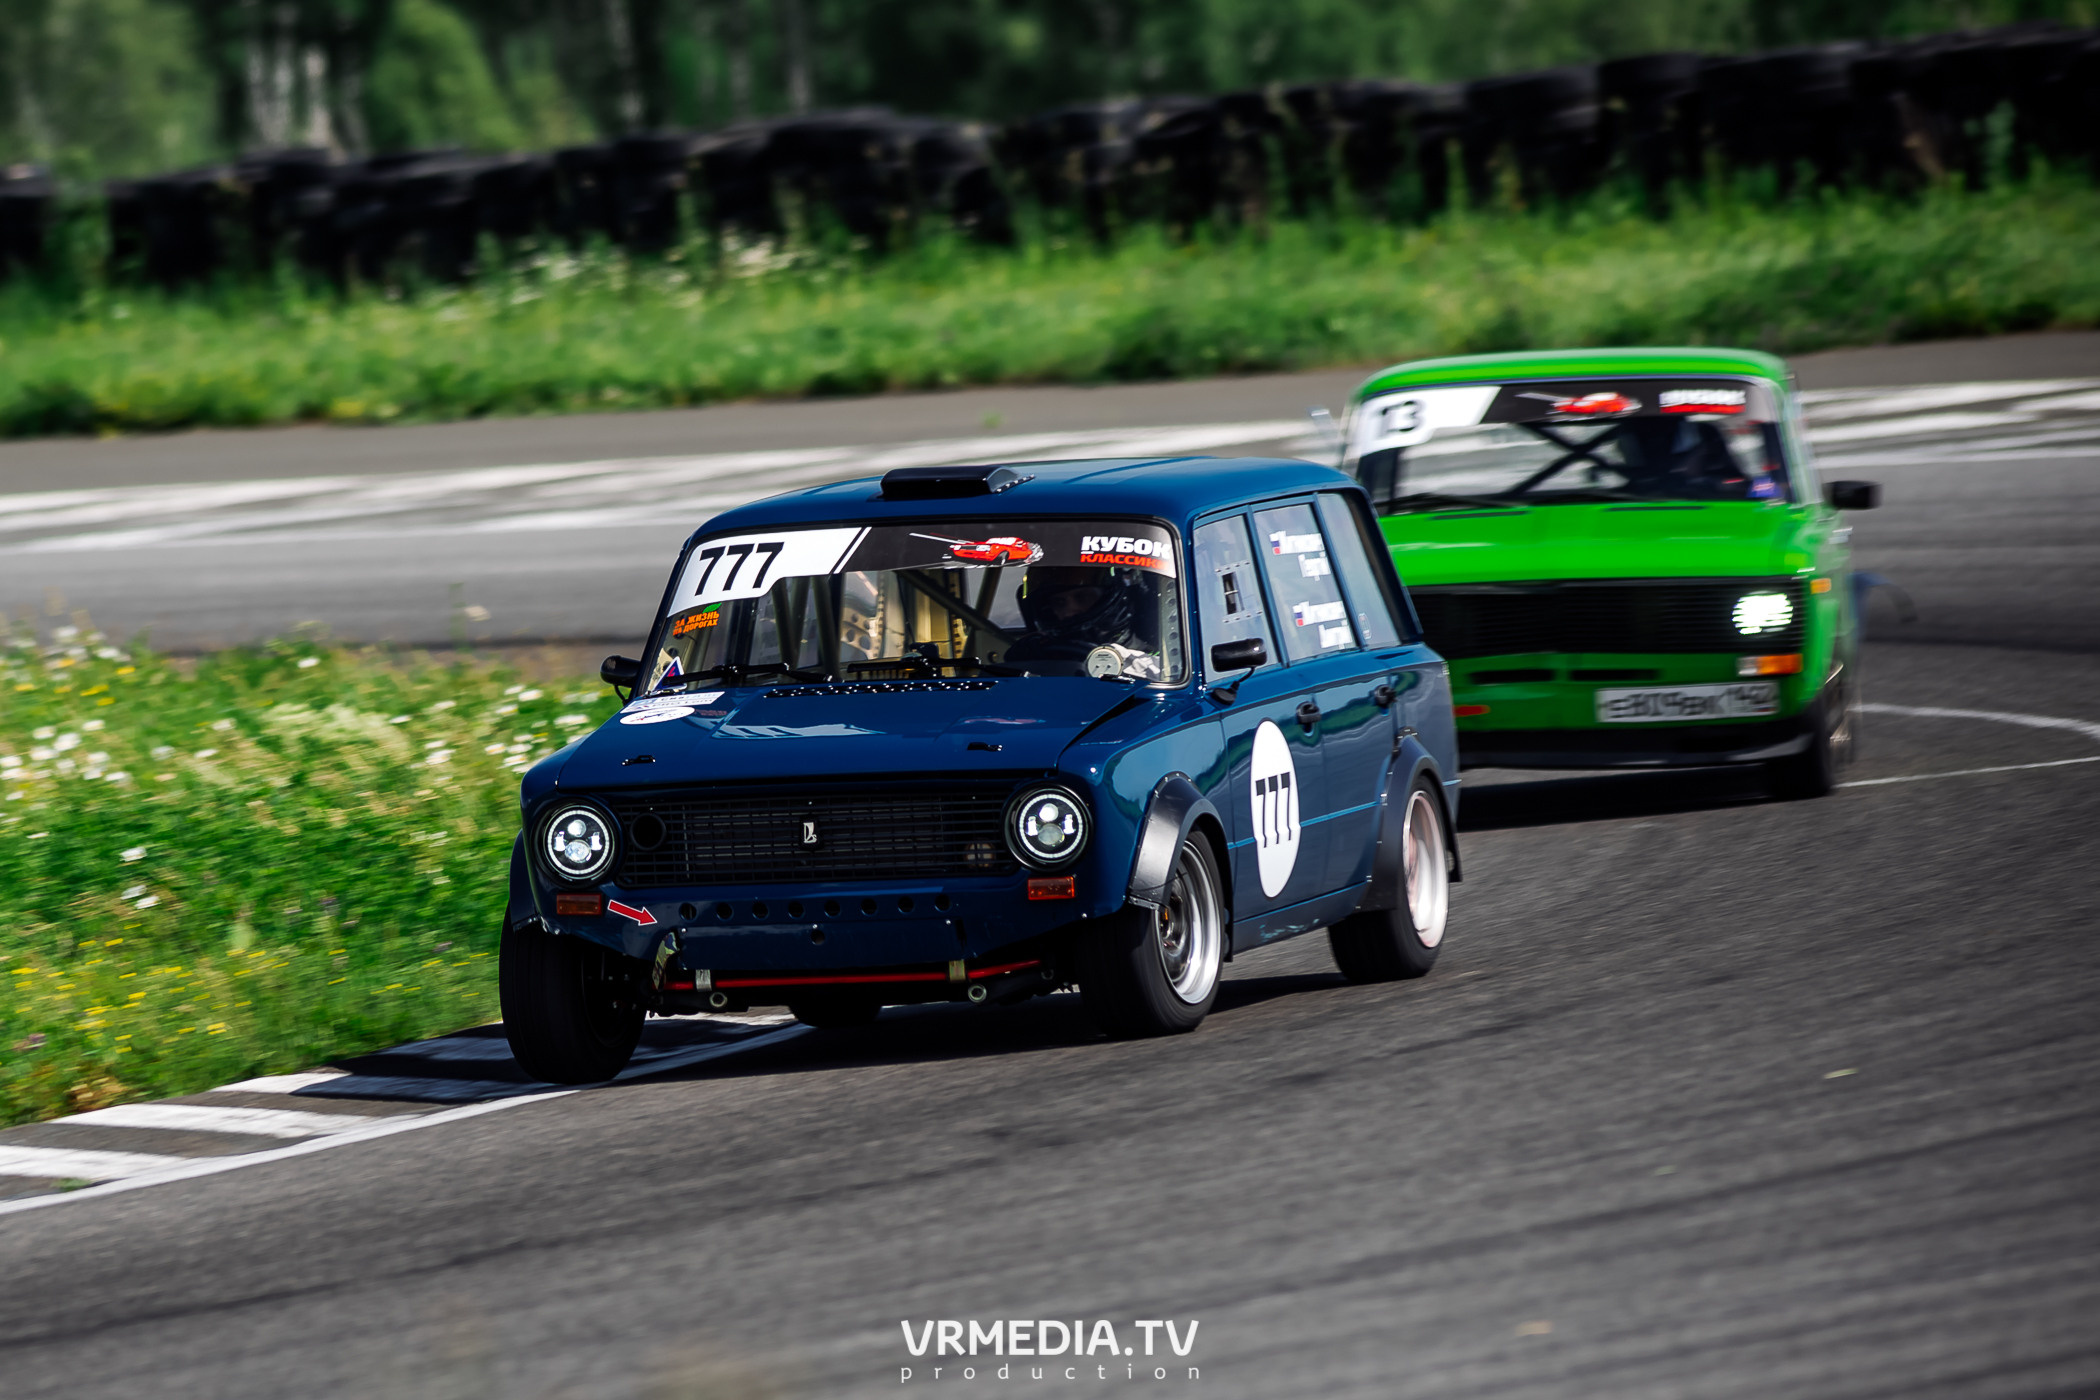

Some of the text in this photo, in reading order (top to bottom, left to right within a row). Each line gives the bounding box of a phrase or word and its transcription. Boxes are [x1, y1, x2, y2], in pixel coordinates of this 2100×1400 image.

[1080, 536, 1172, 559] КУБОК
[694, 541, 785, 597] 777
[683, 618, 718, 634] ДОРОГАХ
[687, 610, 720, 625] ЖИЗНЬ
[1255, 771, 1291, 849] 777
